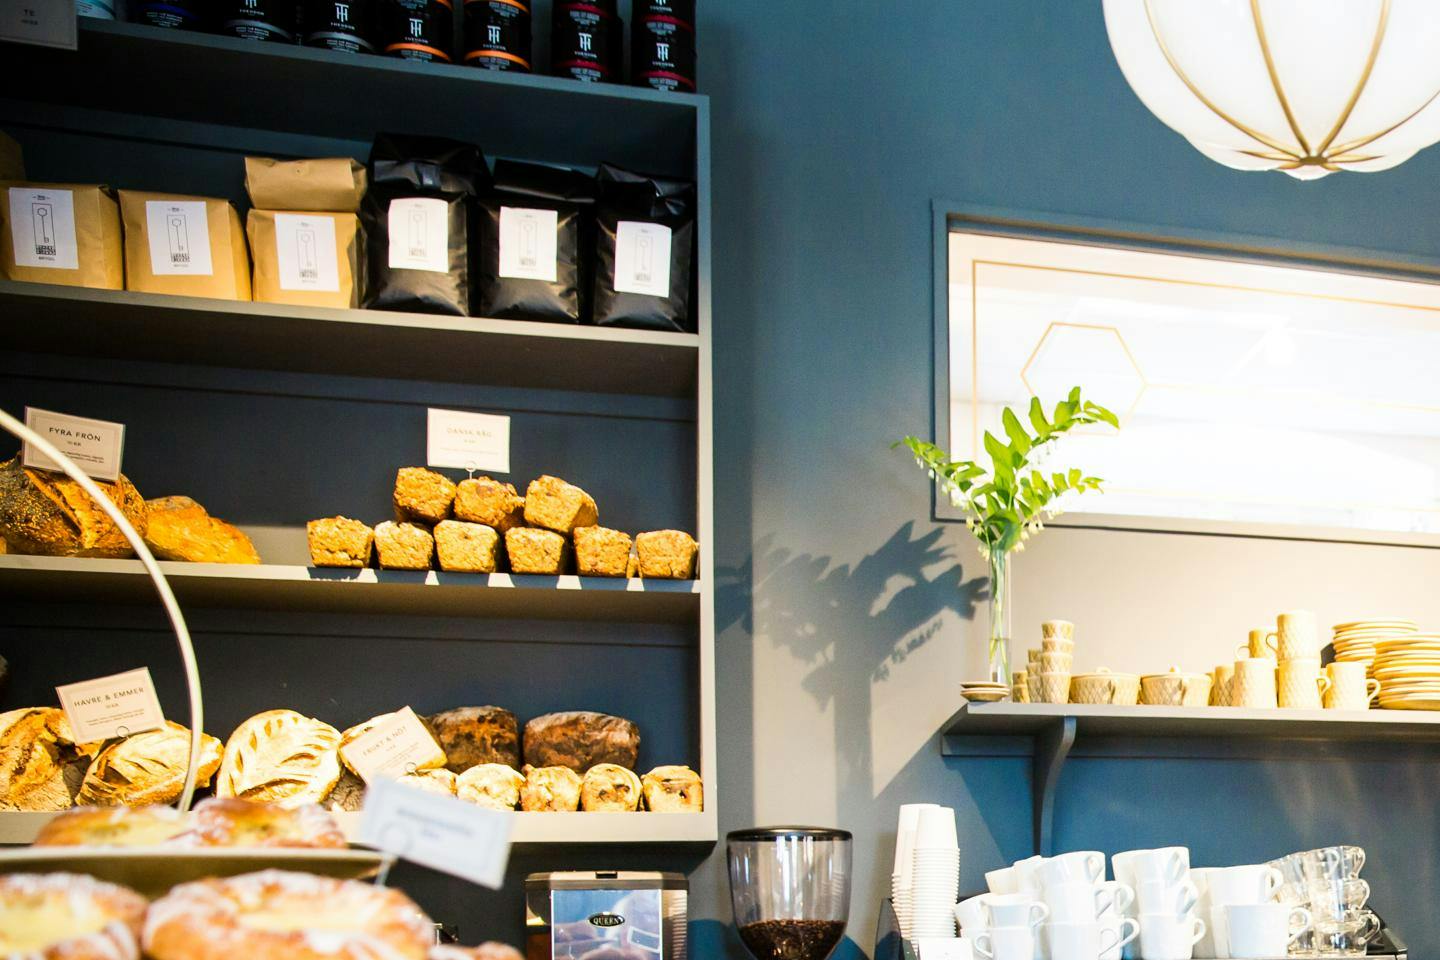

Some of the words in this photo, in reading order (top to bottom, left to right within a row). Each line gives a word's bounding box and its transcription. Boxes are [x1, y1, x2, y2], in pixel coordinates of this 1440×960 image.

[49, 427, 73, 437] FYRA
[75, 431, 101, 442] FRÖN
[74, 696, 102, 707] HAVRE
[113, 687, 144, 698] EMMER
